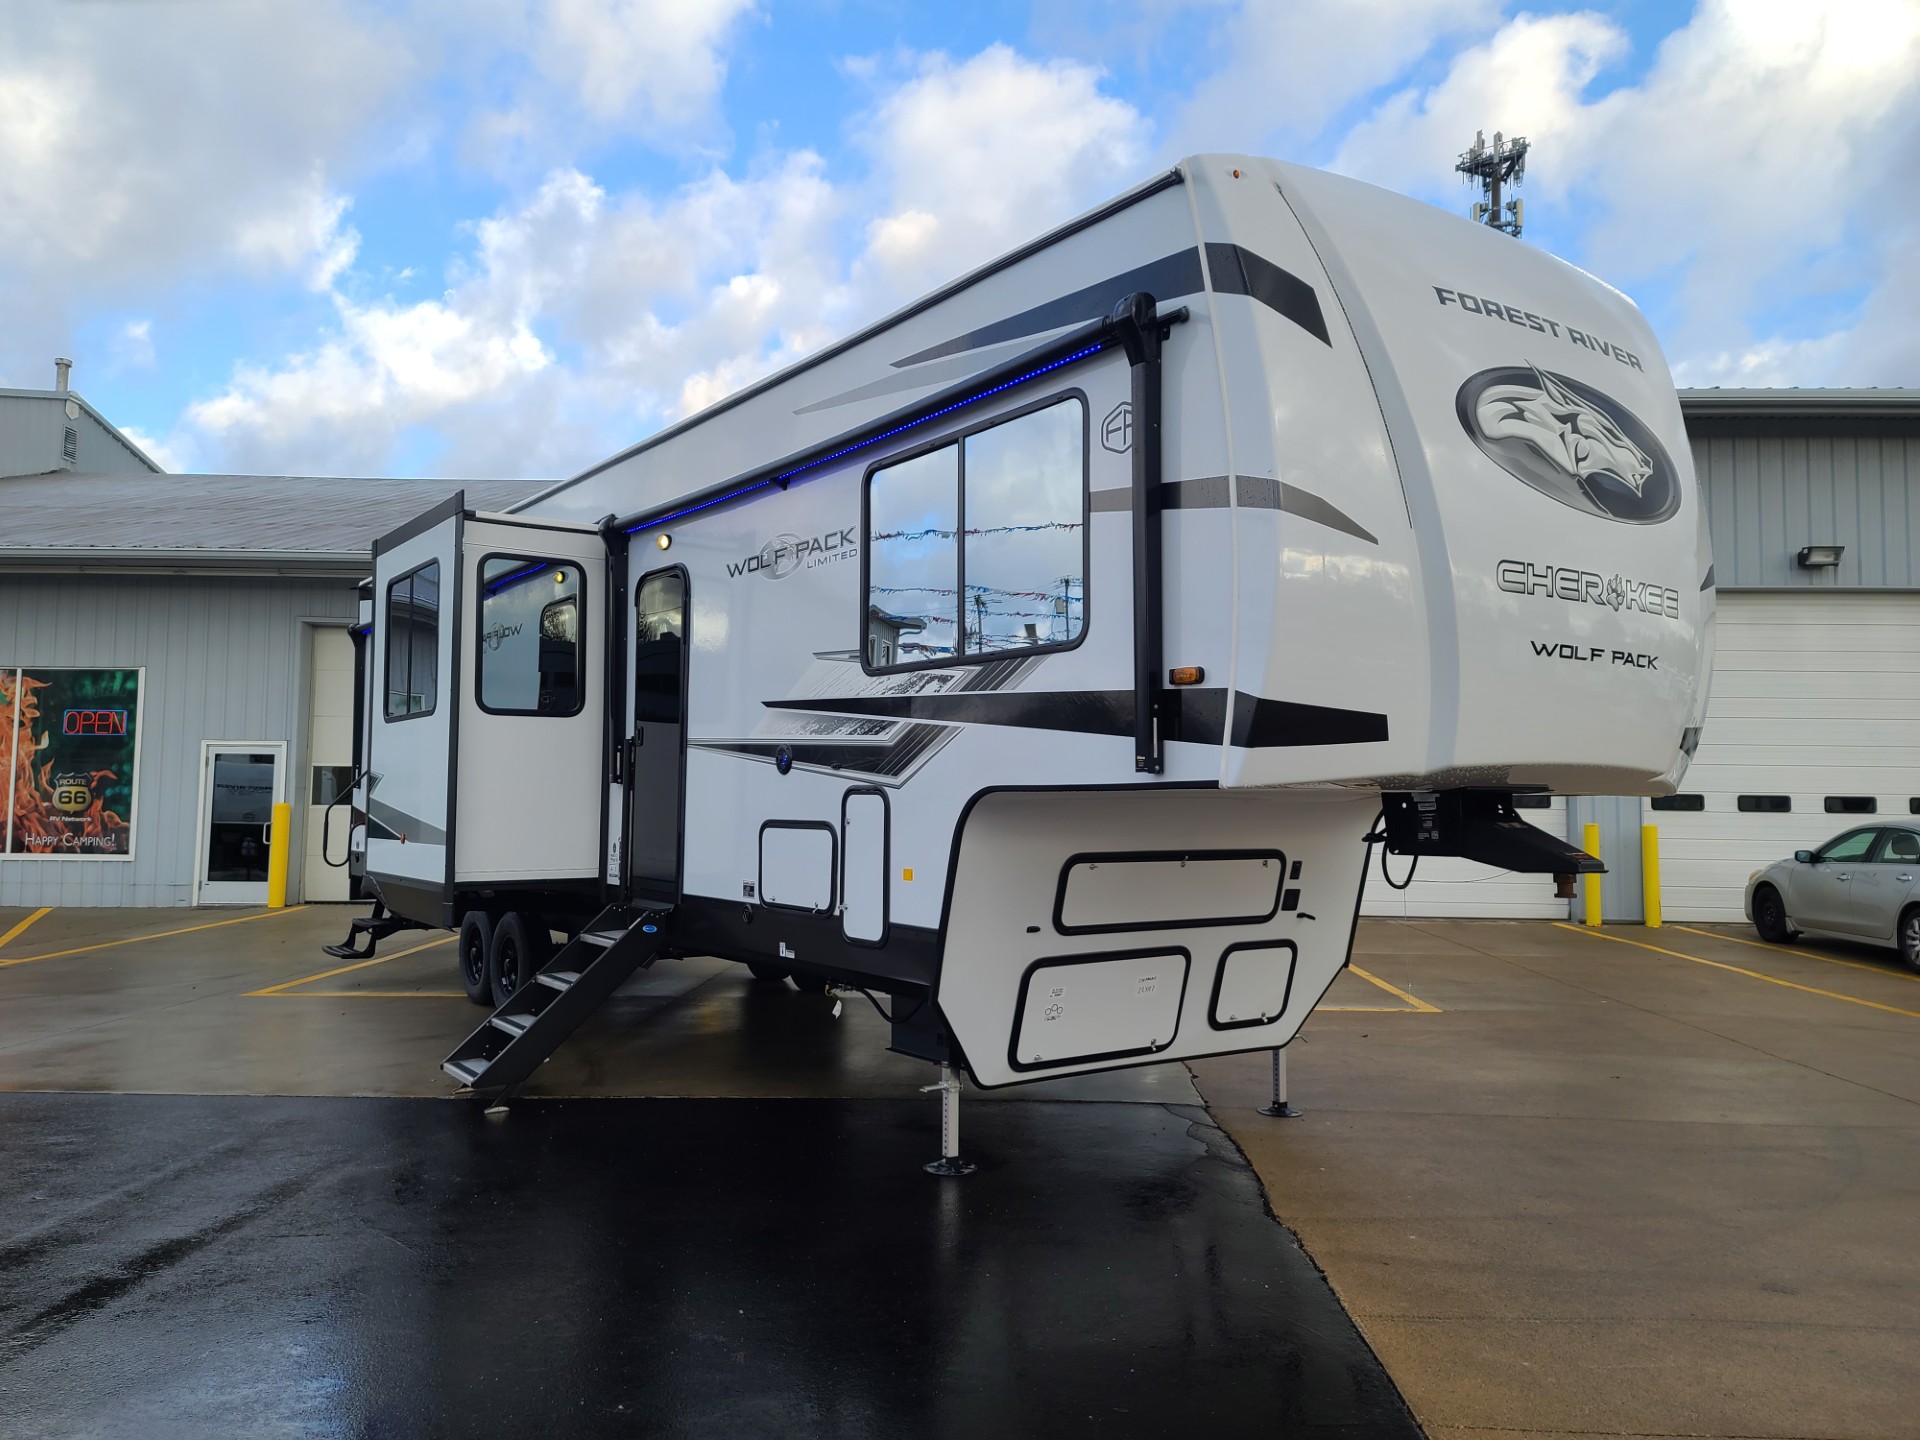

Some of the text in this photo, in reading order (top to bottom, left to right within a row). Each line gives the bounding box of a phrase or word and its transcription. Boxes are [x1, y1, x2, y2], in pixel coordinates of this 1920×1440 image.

[1431, 285, 1645, 374] FOREST RIVER
[726, 524, 857, 578] WOLF PACK
[806, 548, 858, 569] LIMITED
[1530, 640, 1659, 670] WOLF PACK
[64, 710, 127, 734] OPEN
[58, 790, 87, 805] 66
[25, 832, 58, 847] HAPPY
